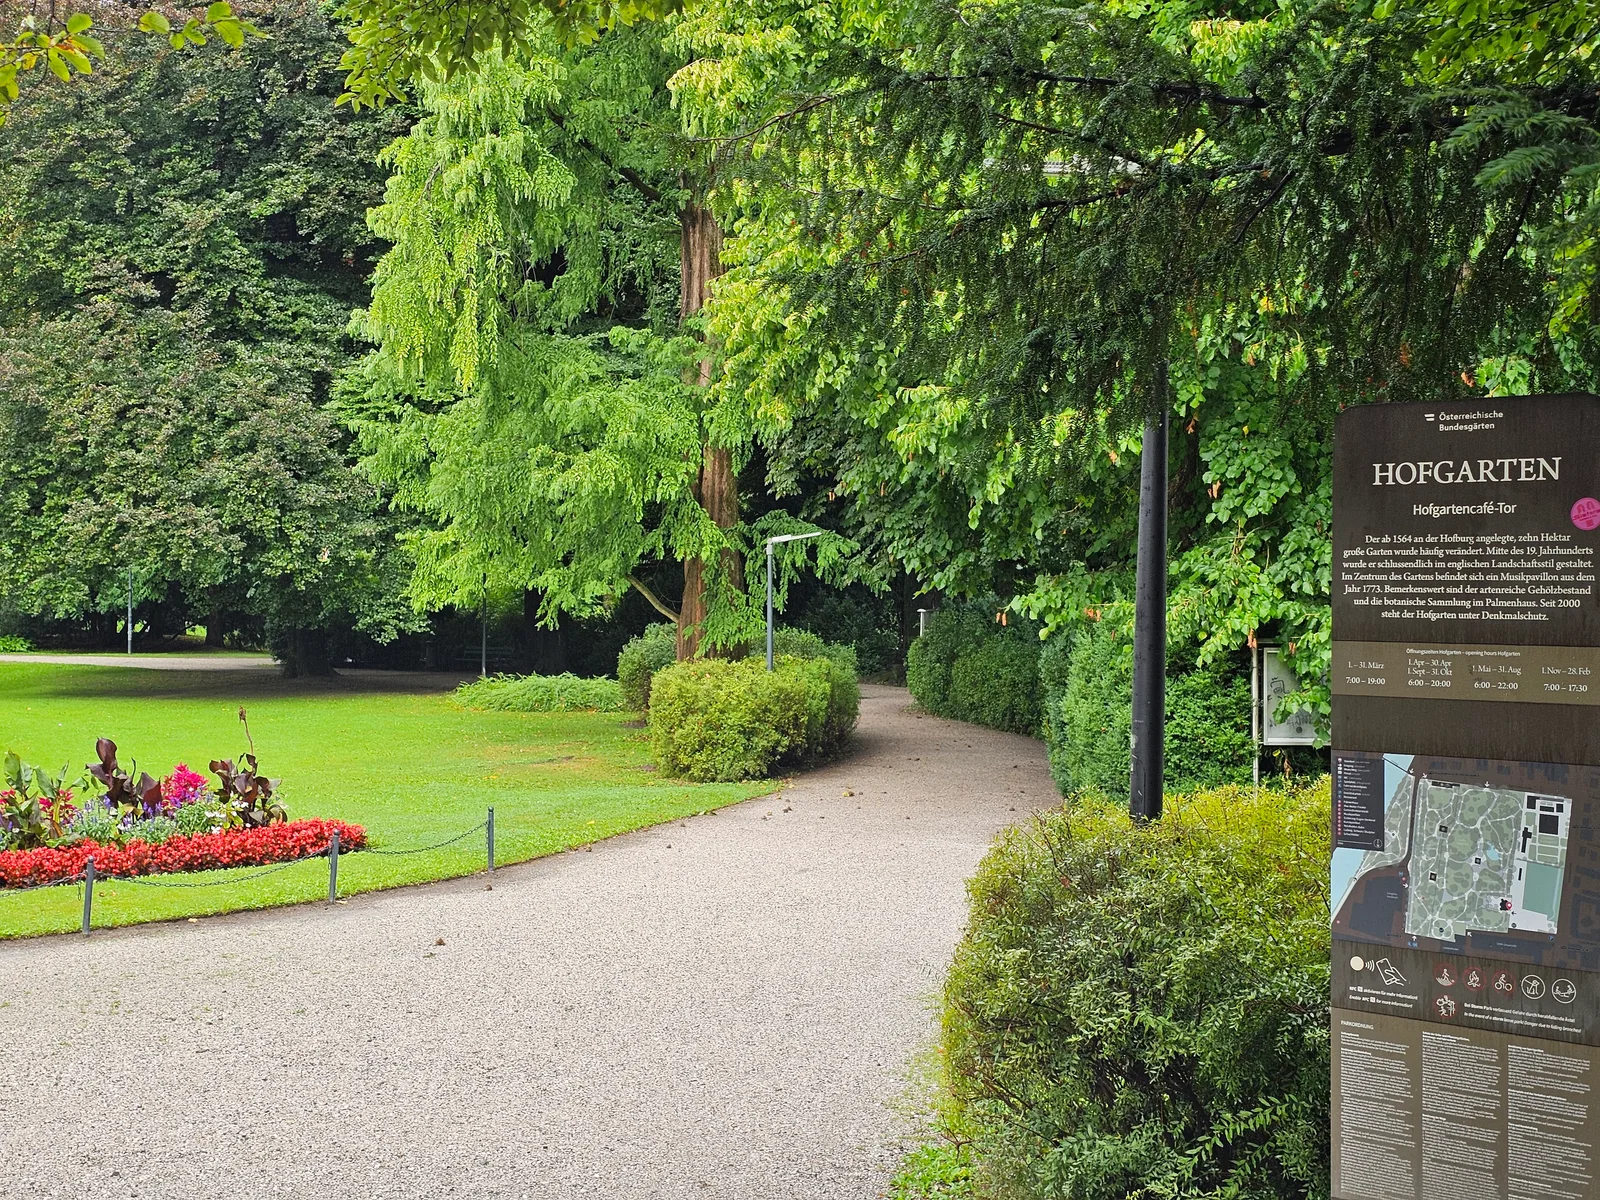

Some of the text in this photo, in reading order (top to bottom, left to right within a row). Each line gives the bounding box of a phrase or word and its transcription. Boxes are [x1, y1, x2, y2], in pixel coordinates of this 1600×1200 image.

[1438, 410, 1504, 421] Österreichische
[1439, 422, 1495, 431] Bundesgärten
[1372, 458, 1562, 485] HOFGARTEN
[1413, 501, 1517, 518] Hofgartencafé-Tor
[1365, 535, 1380, 543] Der
[1381, 534, 1391, 543] ab
[1393, 534, 1412, 543] 1564
[1425, 534, 1439, 542] der
[1440, 534, 1475, 545] Hofburg
[1475, 533, 1517, 545] angelegte,
[1518, 533, 1539, 542] zehn
[1540, 533, 1571, 542] Hektar
[1343, 545, 1593, 559] große Garten wurde häufig verändert. Mitte des 19. Jahrhunderts
[1342, 559, 1367, 568] wurde
[1377, 559, 1433, 568] schlussendlich
[1434, 560, 1446, 568] im
[1447, 559, 1490, 570] englischen
[1491, 558, 1554, 568] Landschaftsstil
[1555, 559, 1594, 571] gestaltet.
[1341, 572, 1353, 580] Im
[1353, 572, 1388, 580] Zentrum
[1389, 572, 1402, 581] des
[1403, 572, 1434, 581] Gartens
[1435, 572, 1468, 581] befindet
[1469, 572, 1485, 581] sich
[1485, 573, 1499, 581] ein
[1500, 572, 1559, 583] Musikpavillon
[1576, 572, 1595, 581] dem
[1343, 584, 1591, 595] Jahr 1773. Bemerkenswert sind der artenreiche Gehölzbestand
[1353, 596, 1581, 609] und die botanische Sammlung im Palmenhaus. Seit 2000
[1381, 609, 1400, 618] steht
[1401, 609, 1415, 618] der
[1416, 610, 1457, 621] Hofgarten
[1481, 611, 1549, 620] Denkmalschutz.
[1359, 661, 1367, 669] 31.
[1413, 659, 1424, 667] Apr
[1440, 659, 1452, 668] Apr
[1412, 668, 1425, 677] Sept
[1440, 667, 1452, 676] Okt
[1498, 665, 1507, 673] 31.
[1507, 666, 1522, 676] Aug
[1547, 666, 1561, 674] Nov
[1567, 667, 1577, 675] 28.
[1578, 667, 1591, 675] Feb
[1346, 676, 1361, 684] 7:00
[1368, 677, 1386, 685] 19:00
[1408, 678, 1424, 686] 6:00
[1474, 681, 1491, 689] 6:00
[1497, 682, 1518, 690] 22:00
[1544, 683, 1560, 691] 7:00
[1568, 684, 1588, 692] 17:30
[1340, 1020, 1374, 1030] PARKORDNUNG
